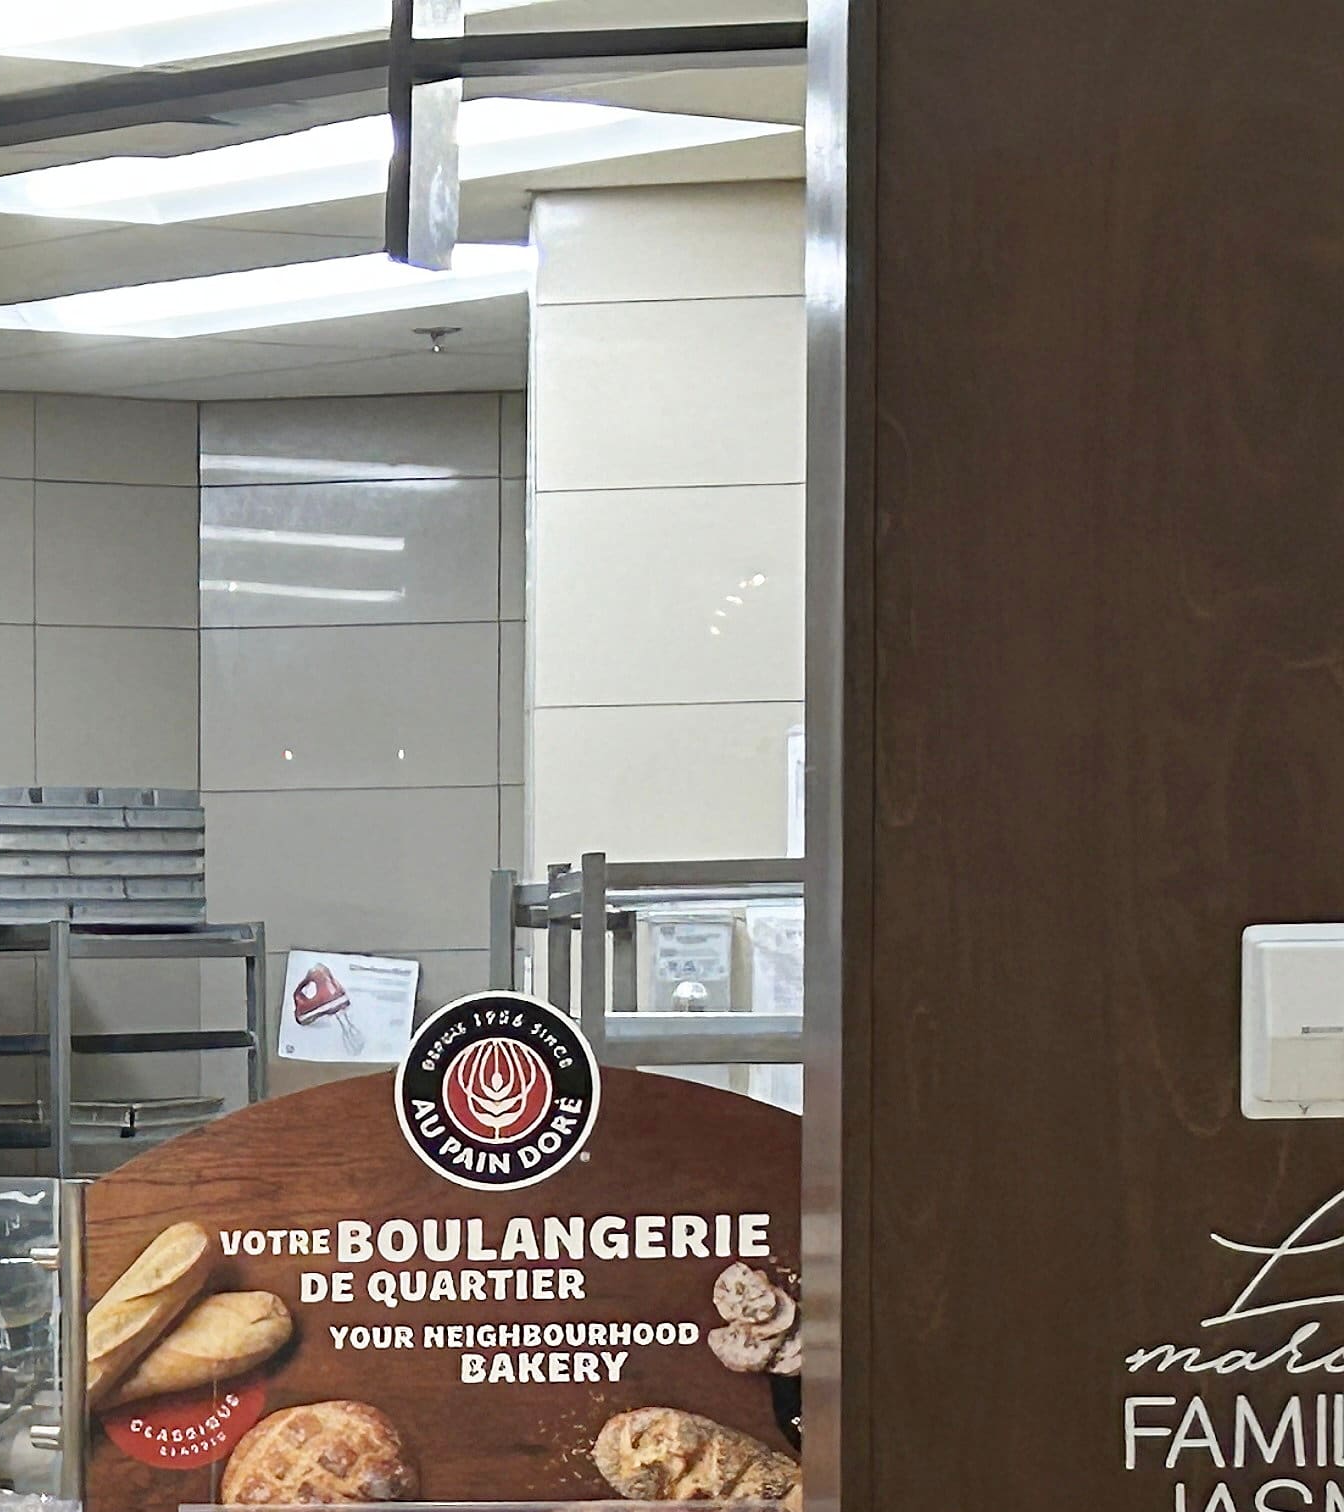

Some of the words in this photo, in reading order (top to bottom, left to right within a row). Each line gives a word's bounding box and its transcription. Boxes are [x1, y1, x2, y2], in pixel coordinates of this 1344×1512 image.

[412, 1099, 446, 1139] AU
[439, 1136, 511, 1174] PAIN
[517, 1096, 583, 1169] DORÉ
[219, 1227, 333, 1257] VOTRE
[335, 1212, 772, 1264] BOULANGERIE
[299, 1271, 354, 1303] DE
[366, 1268, 587, 1309] QUARTIER
[329, 1324, 414, 1350] YOUR
[422, 1322, 700, 1350] NEIGHBOURHOOD
[459, 1351, 629, 1385] BAKERY
